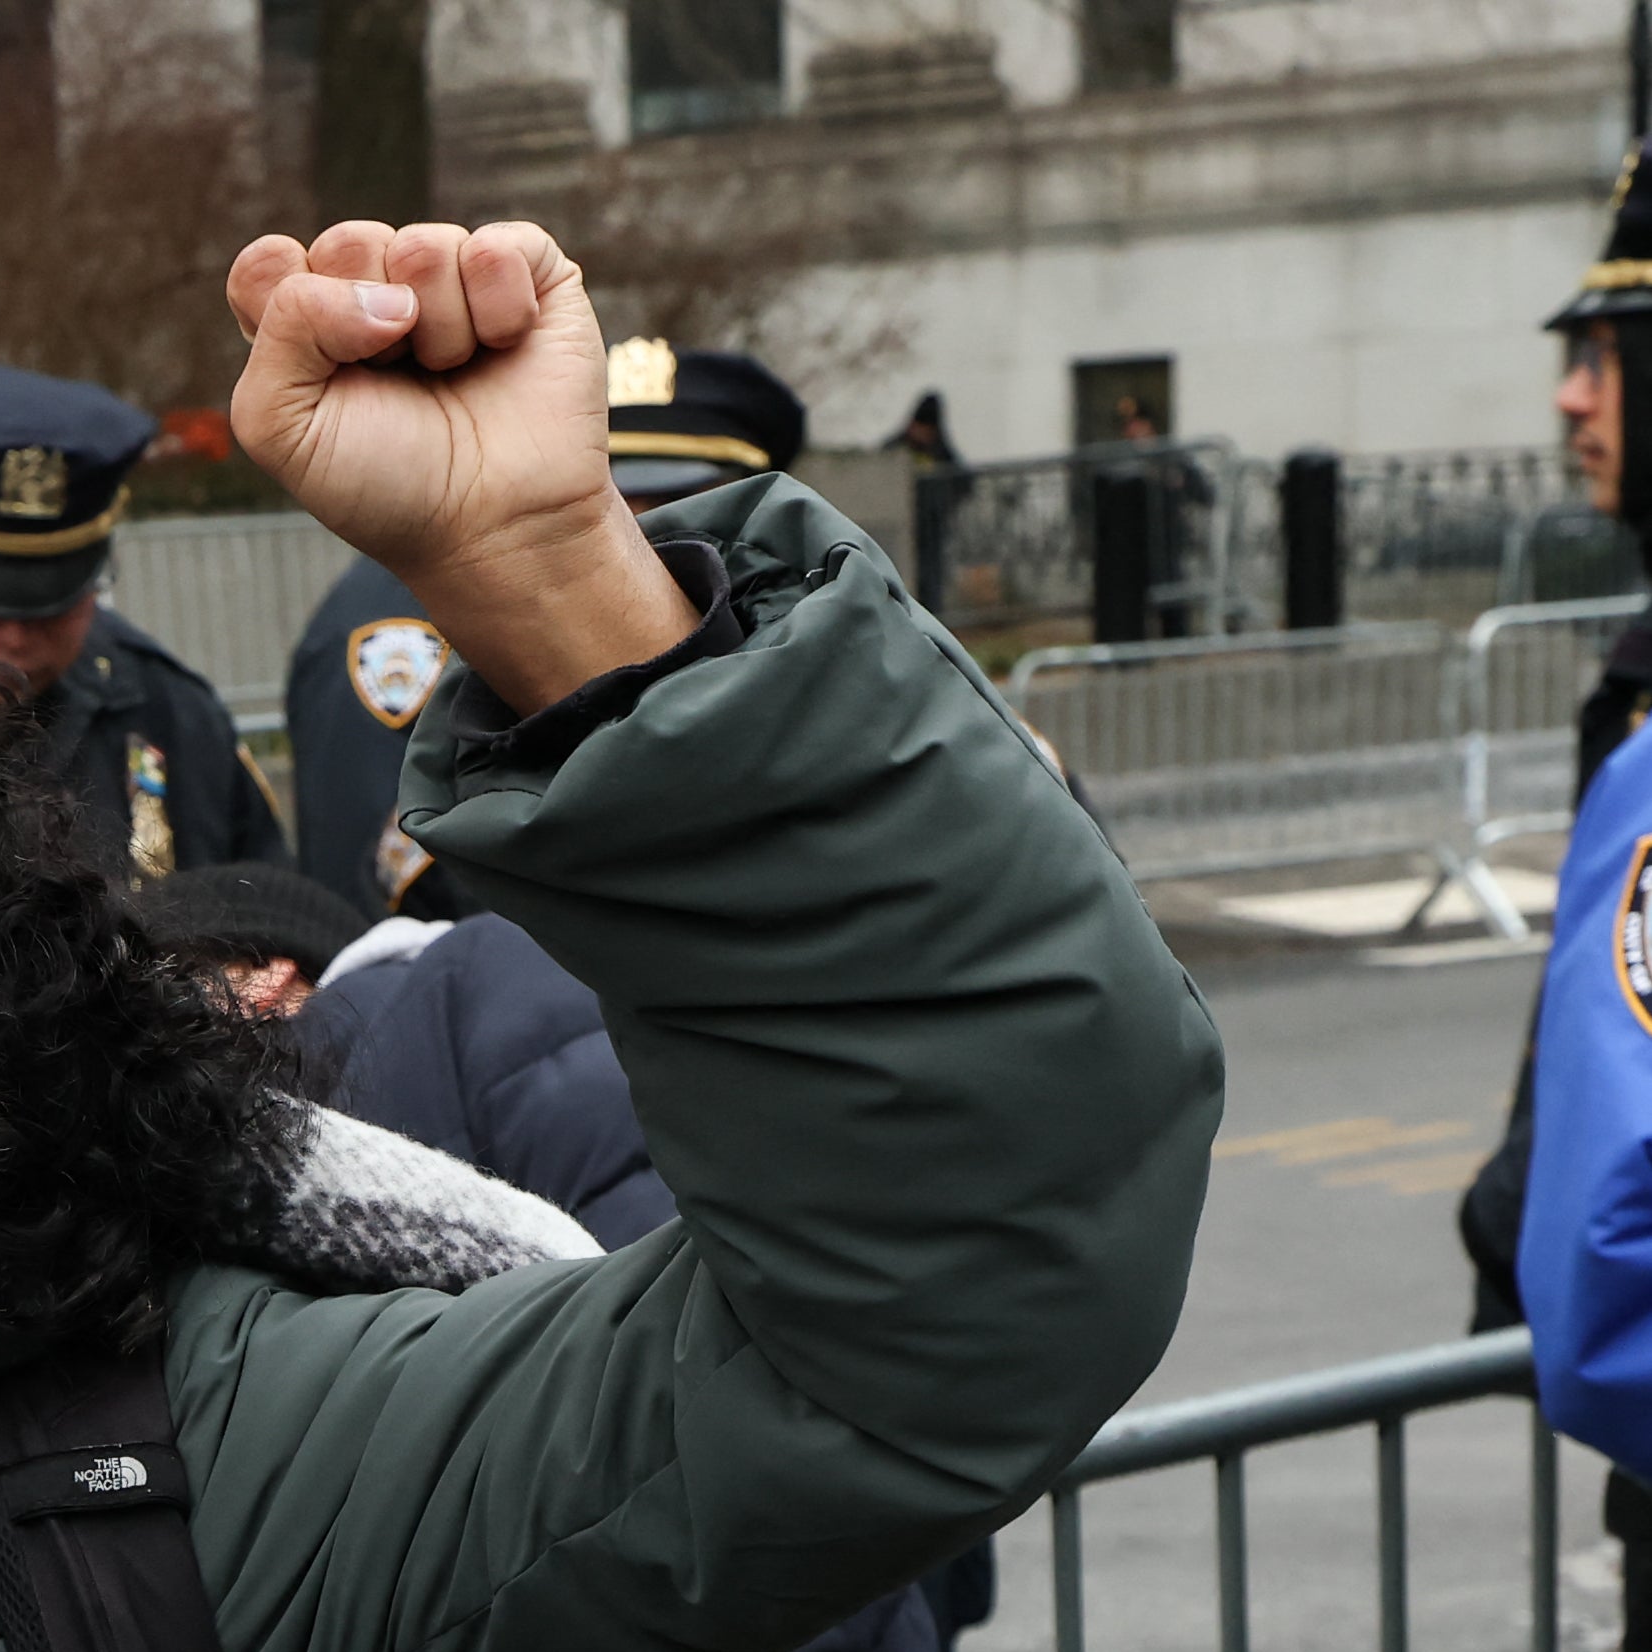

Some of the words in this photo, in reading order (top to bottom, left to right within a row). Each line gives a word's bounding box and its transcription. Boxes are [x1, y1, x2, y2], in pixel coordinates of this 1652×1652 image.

[94, 1457, 119, 1469] THE
[74, 1468, 121, 1483] NORTH
[88, 1478, 121, 1493] FACE
